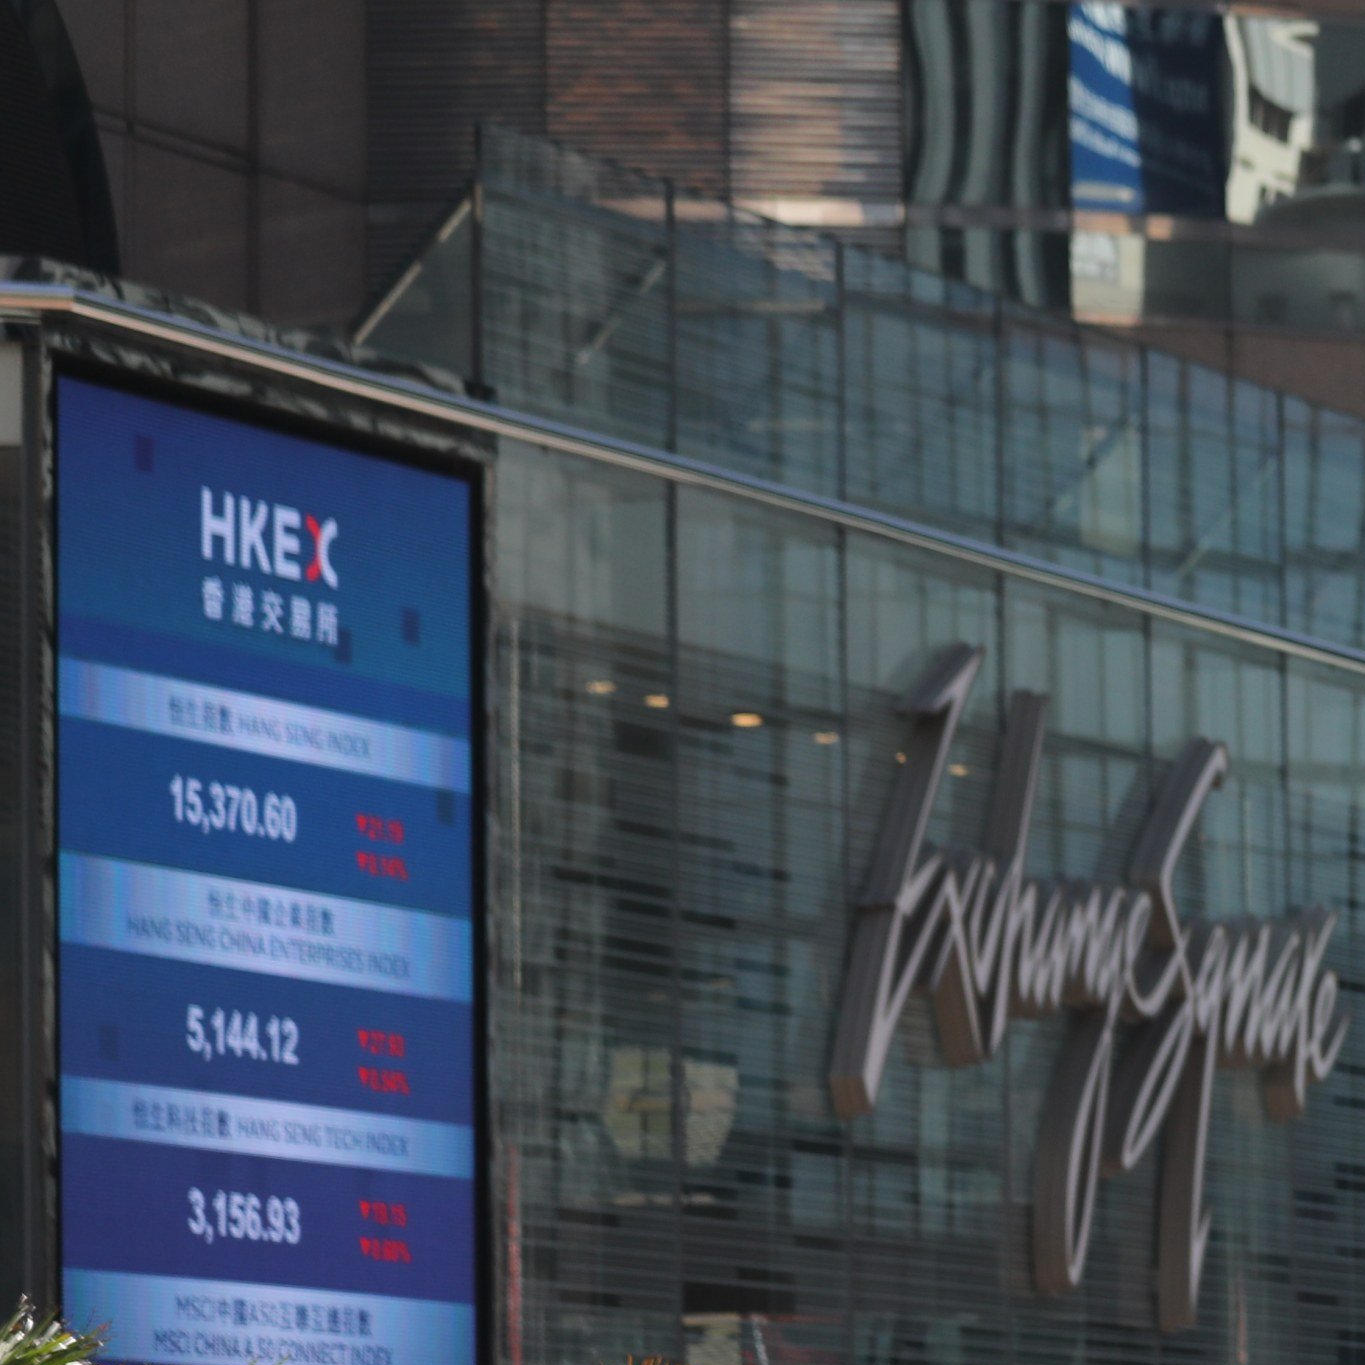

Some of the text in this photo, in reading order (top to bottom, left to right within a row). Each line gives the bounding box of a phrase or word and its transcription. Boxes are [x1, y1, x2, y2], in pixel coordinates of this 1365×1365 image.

[202, 485, 338, 590] HKEX
[203, 575, 338, 646] 香港交易所
[169, 772, 297, 843] 15,370.60
[126, 915, 410, 979] HANG SENG CHINA ENTERPRISES INDEX
[186, 1003, 299, 1066] 5,144.12
[237, 1115, 280, 1143] HANG
[283, 1120, 322, 1148] SENG
[324, 1125, 362, 1151] TECH
[366, 1131, 408, 1157] INDEX
[187, 1186, 300, 1245] 3,156.93
[153, 1327, 192, 1355] MSCI
[194, 1331, 241, 1358] CHINA
